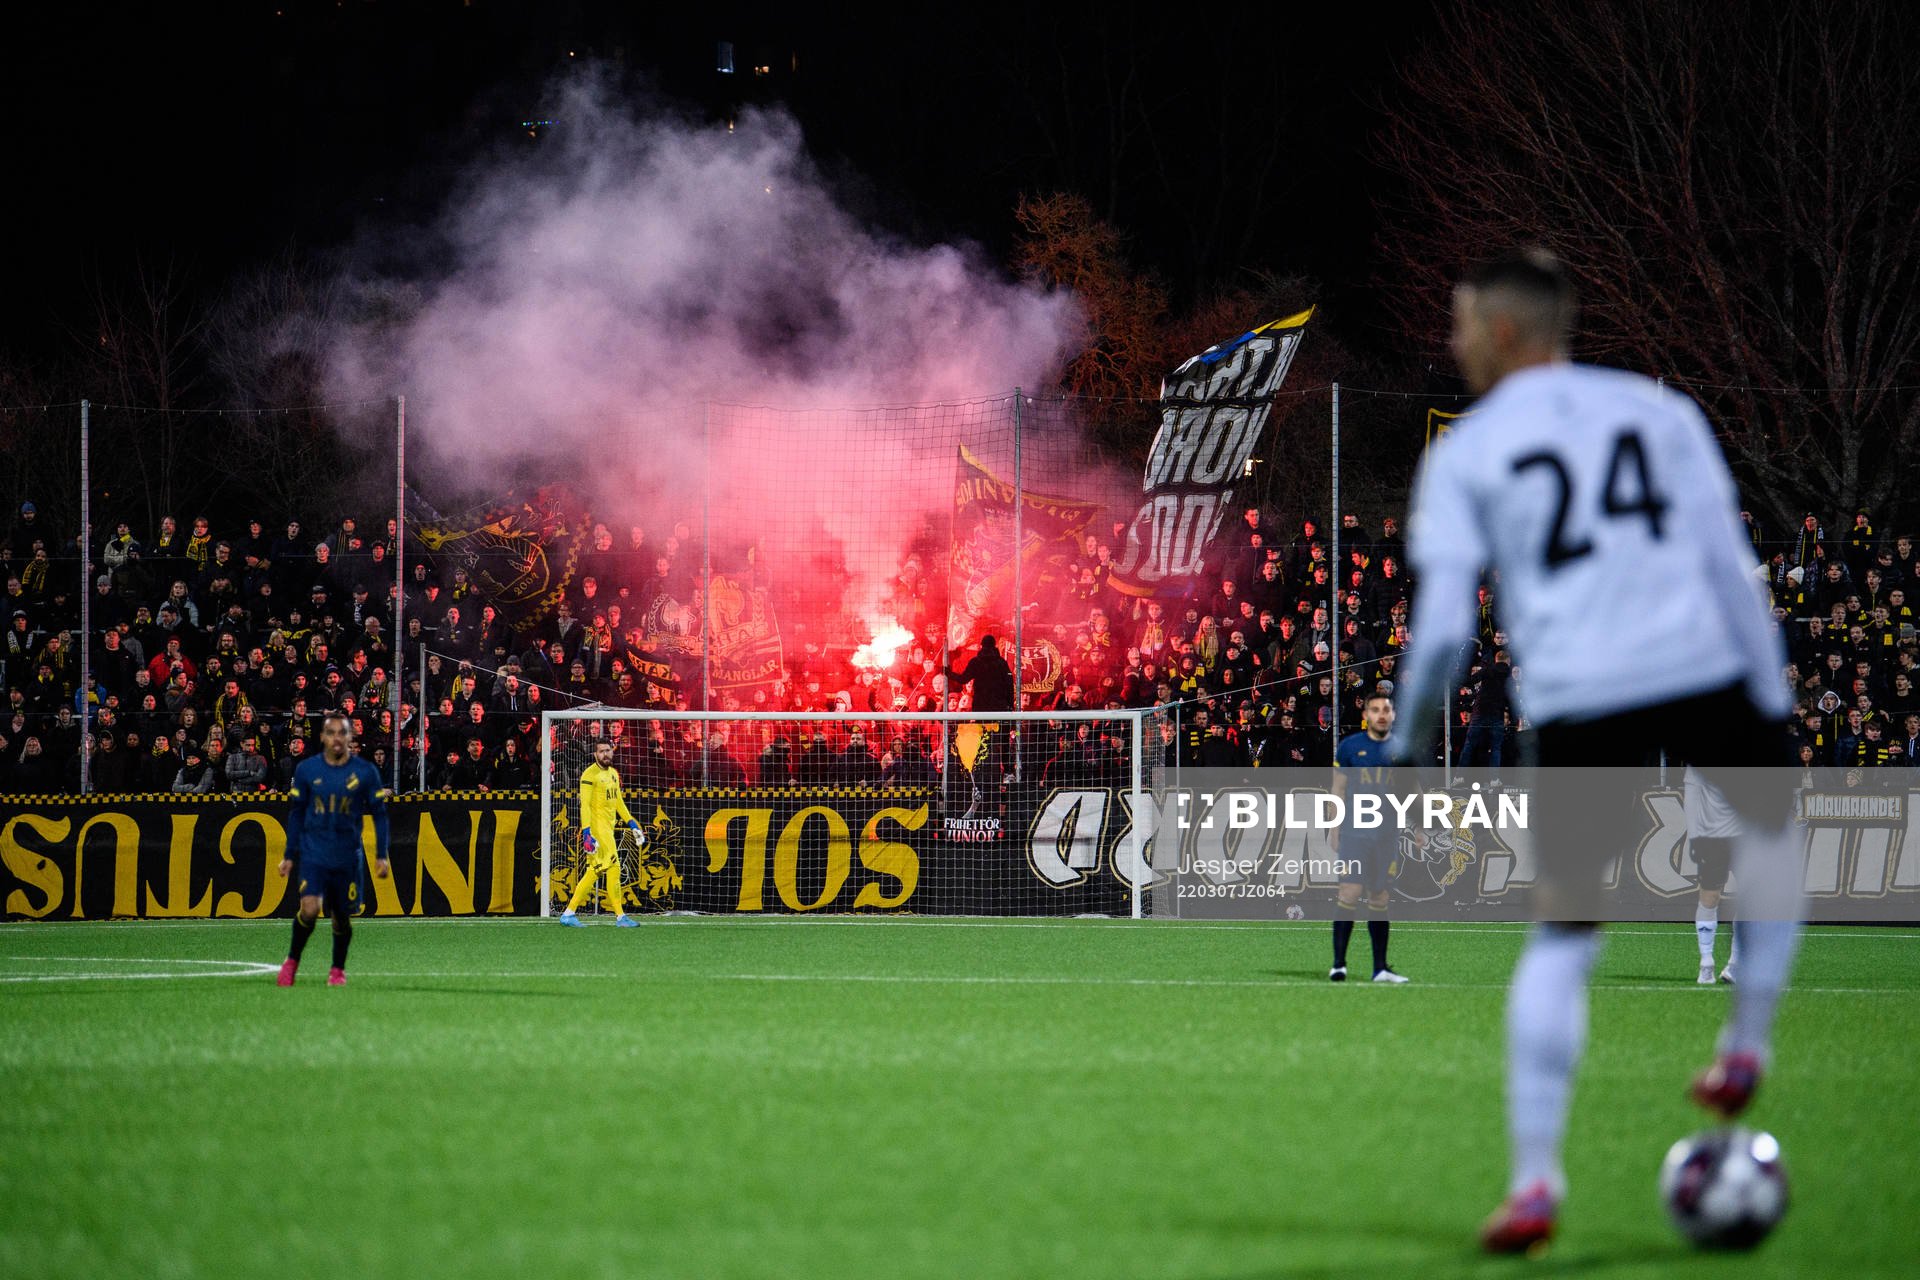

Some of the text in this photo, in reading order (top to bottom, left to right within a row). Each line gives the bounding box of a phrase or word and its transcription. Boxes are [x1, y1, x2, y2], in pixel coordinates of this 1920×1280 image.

[1511, 428, 1672, 570] 24
[944, 817, 999, 830] FRIHET FÖR
[946, 830, 995, 842] JUNIOR
[0, 810, 522, 919] INVCTUS
